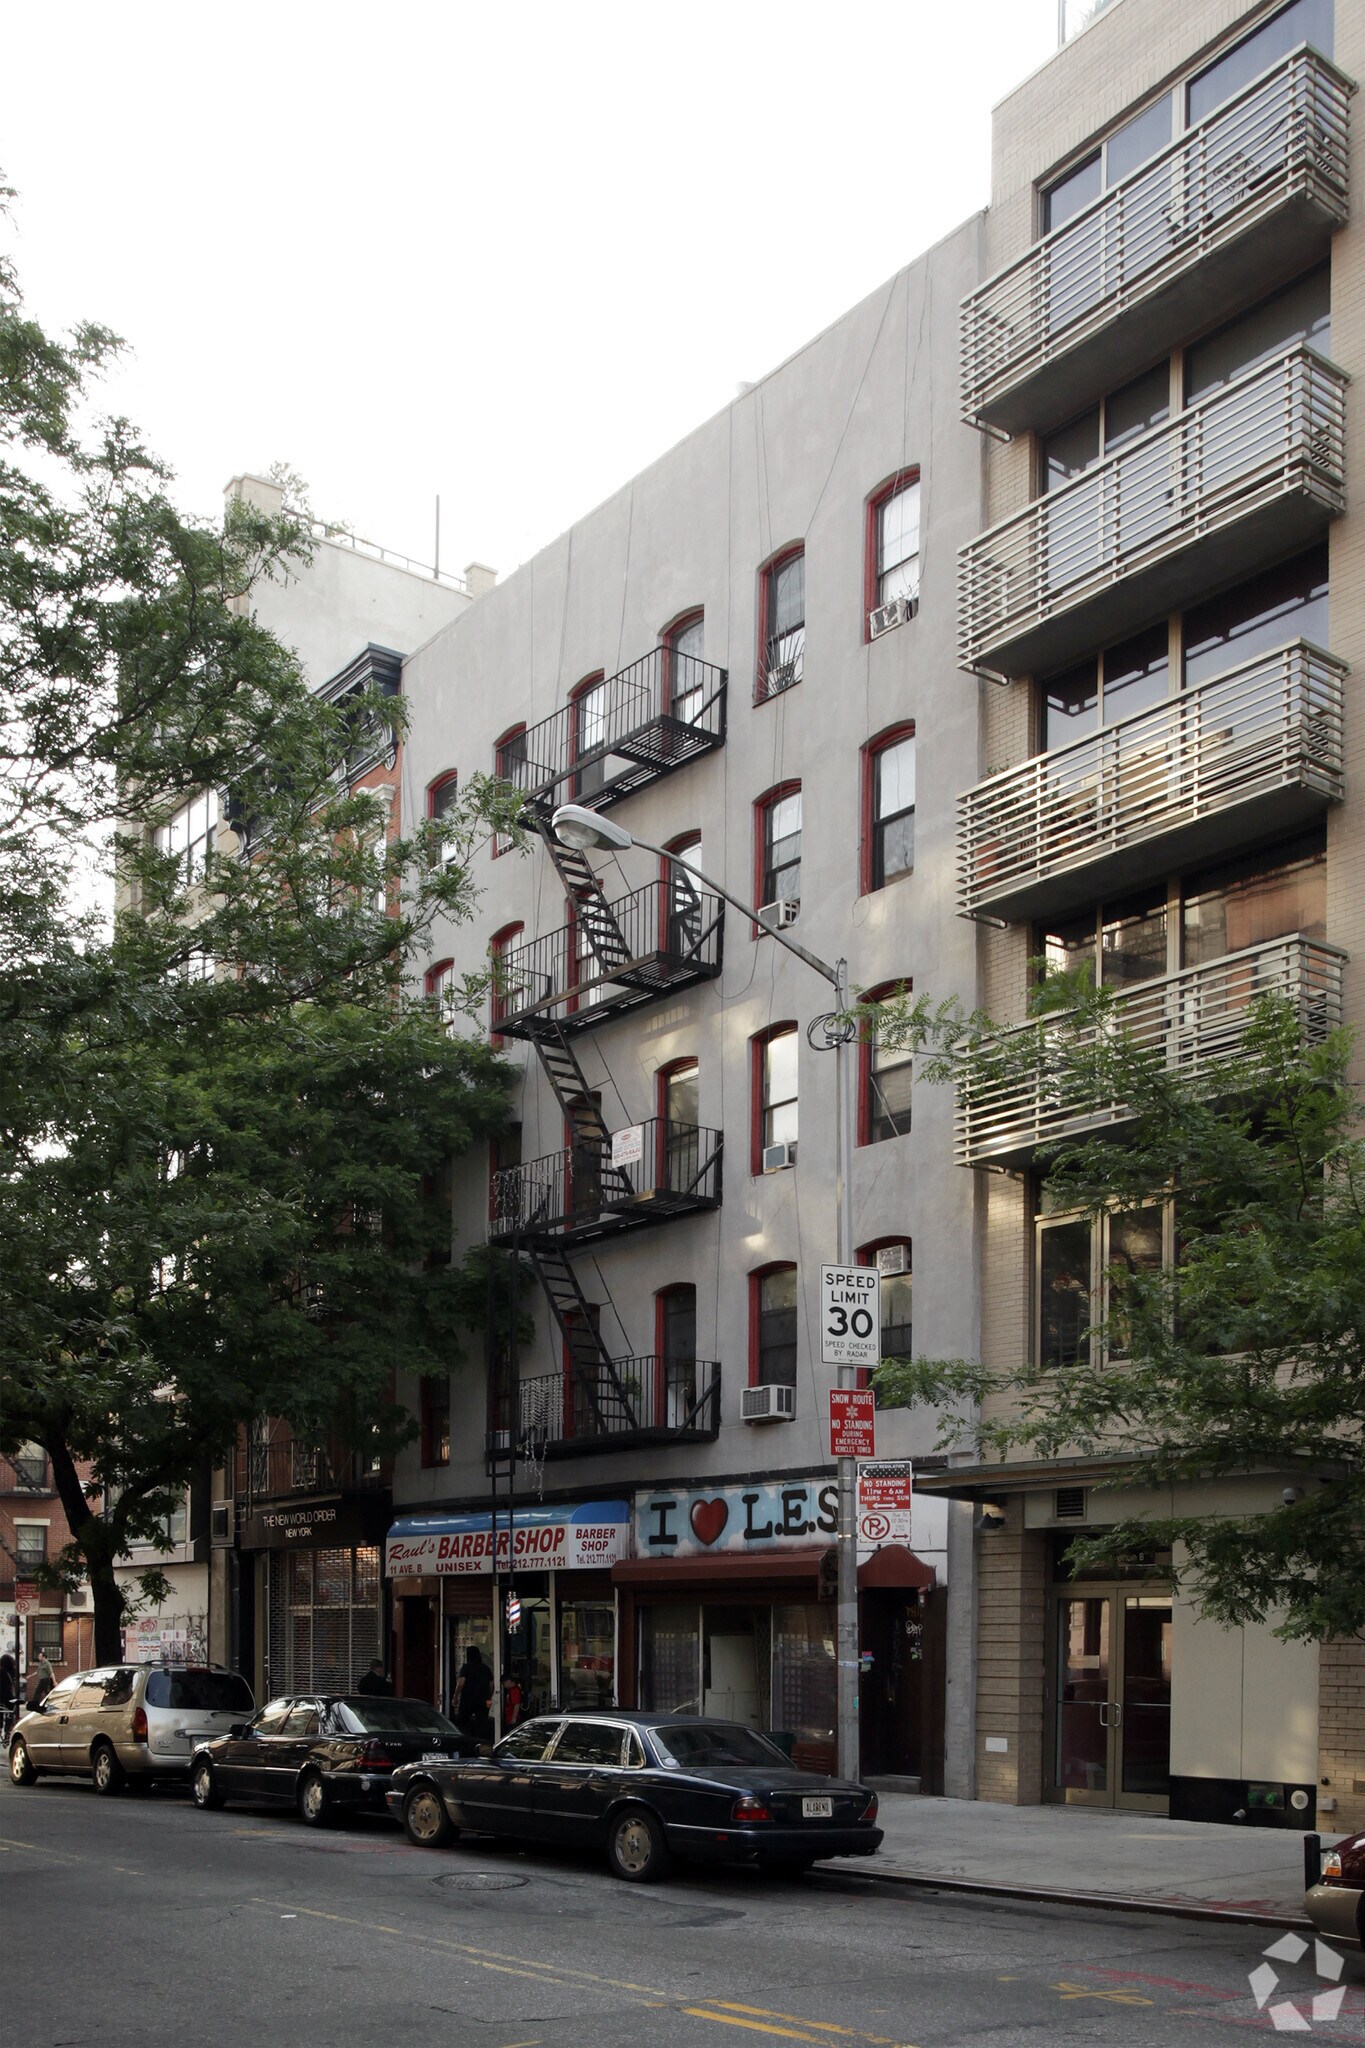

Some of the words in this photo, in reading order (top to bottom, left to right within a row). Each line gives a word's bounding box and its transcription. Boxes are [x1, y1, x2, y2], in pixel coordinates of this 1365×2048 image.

[825, 1273, 875, 1288] SPEED
[831, 1290, 869, 1304] LIMIT
[827, 1306, 873, 1338] 30
[824, 1340, 845, 1348] SPEED
[848, 1342, 876, 1350] CHECKED
[846, 1350, 868, 1358] RADAR
[831, 1394, 850, 1404] SNOW
[852, 1394, 872, 1405] ROUTE
[832, 1419, 840, 1429] NO
[844, 1420, 872, 1430] STANDING
[836, 1438, 870, 1446] EMERGENCY
[876, 1480, 906, 1488] STANDING
[262, 1516, 275, 1527] THE
[275, 1514, 289, 1526] NEW
[290, 1511, 312, 1524] WORLD
[314, 1508, 336, 1522] ORDER
[648, 1501, 678, 1545] I
[286, 1528, 298, 1538] NEW
[298, 1527, 312, 1536] YORK
[576, 1528, 616, 1540] BARBER
[388, 1538, 436, 1562] Raul's
[437, 1532, 510, 1560] BARBER
[513, 1527, 566, 1555] SHOP
[581, 1540, 608, 1552] SHOP
[390, 1566, 397, 1574] 11
[399, 1564, 414, 1574] AVE.
[416, 1564, 422, 1573] B
[436, 1561, 482, 1573] UNISEX
